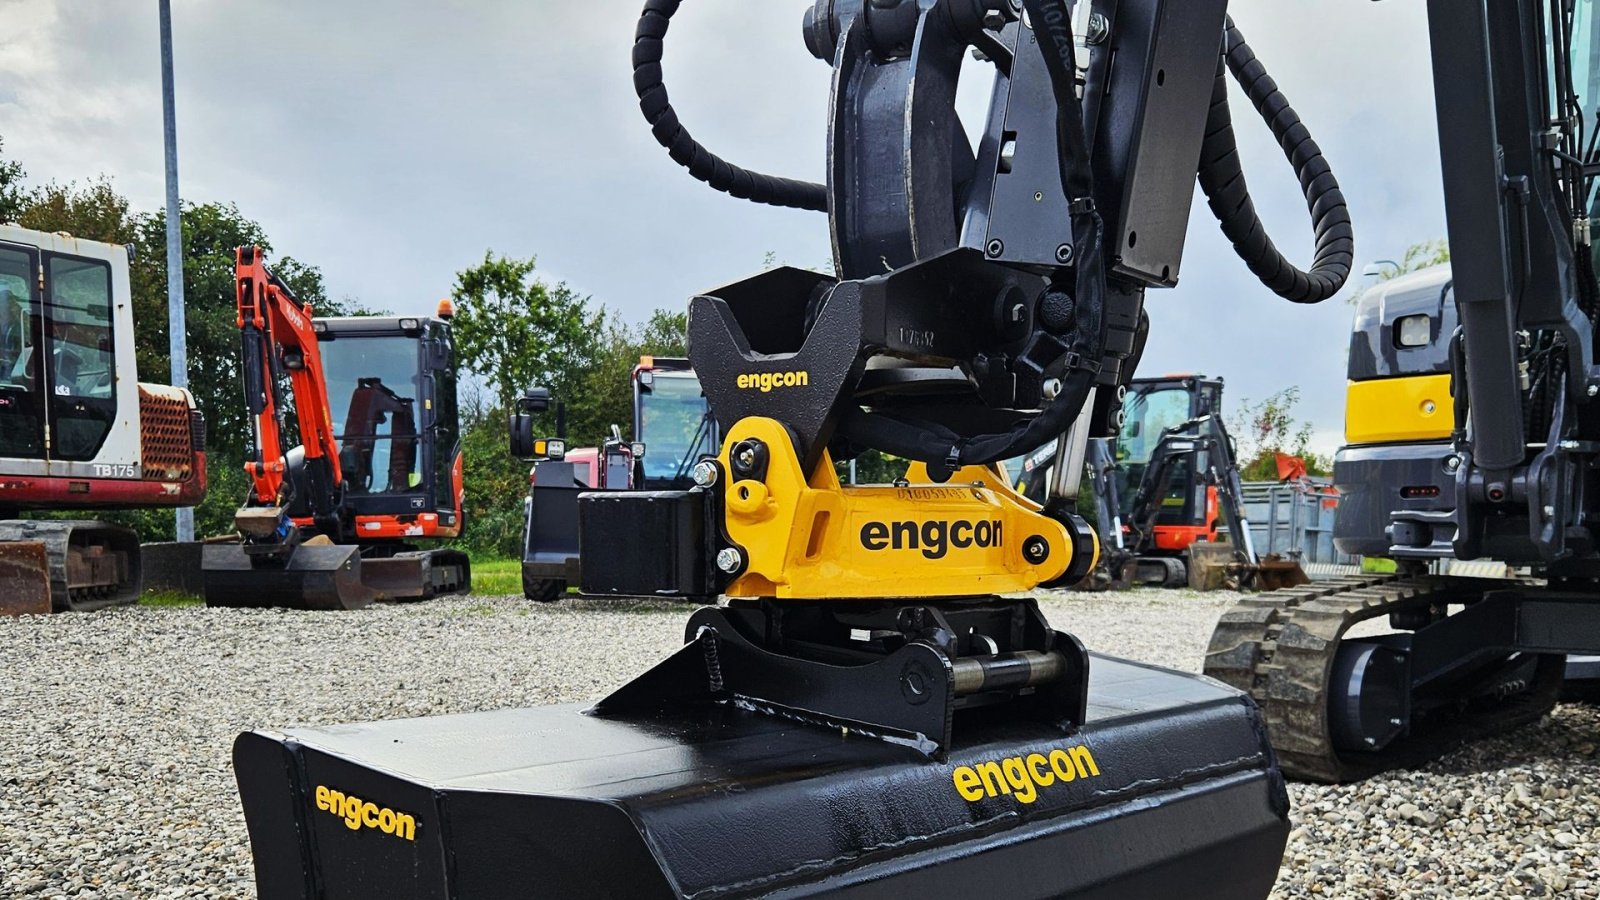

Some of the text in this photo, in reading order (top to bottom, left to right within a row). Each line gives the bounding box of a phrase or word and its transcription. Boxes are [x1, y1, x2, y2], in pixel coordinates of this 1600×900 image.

[737, 371, 808, 392] engcon
[93, 464, 134, 477] TB175
[860, 520, 1002, 559] engcon
[953, 745, 1100, 803] engcon
[316, 785, 415, 840] engcon
